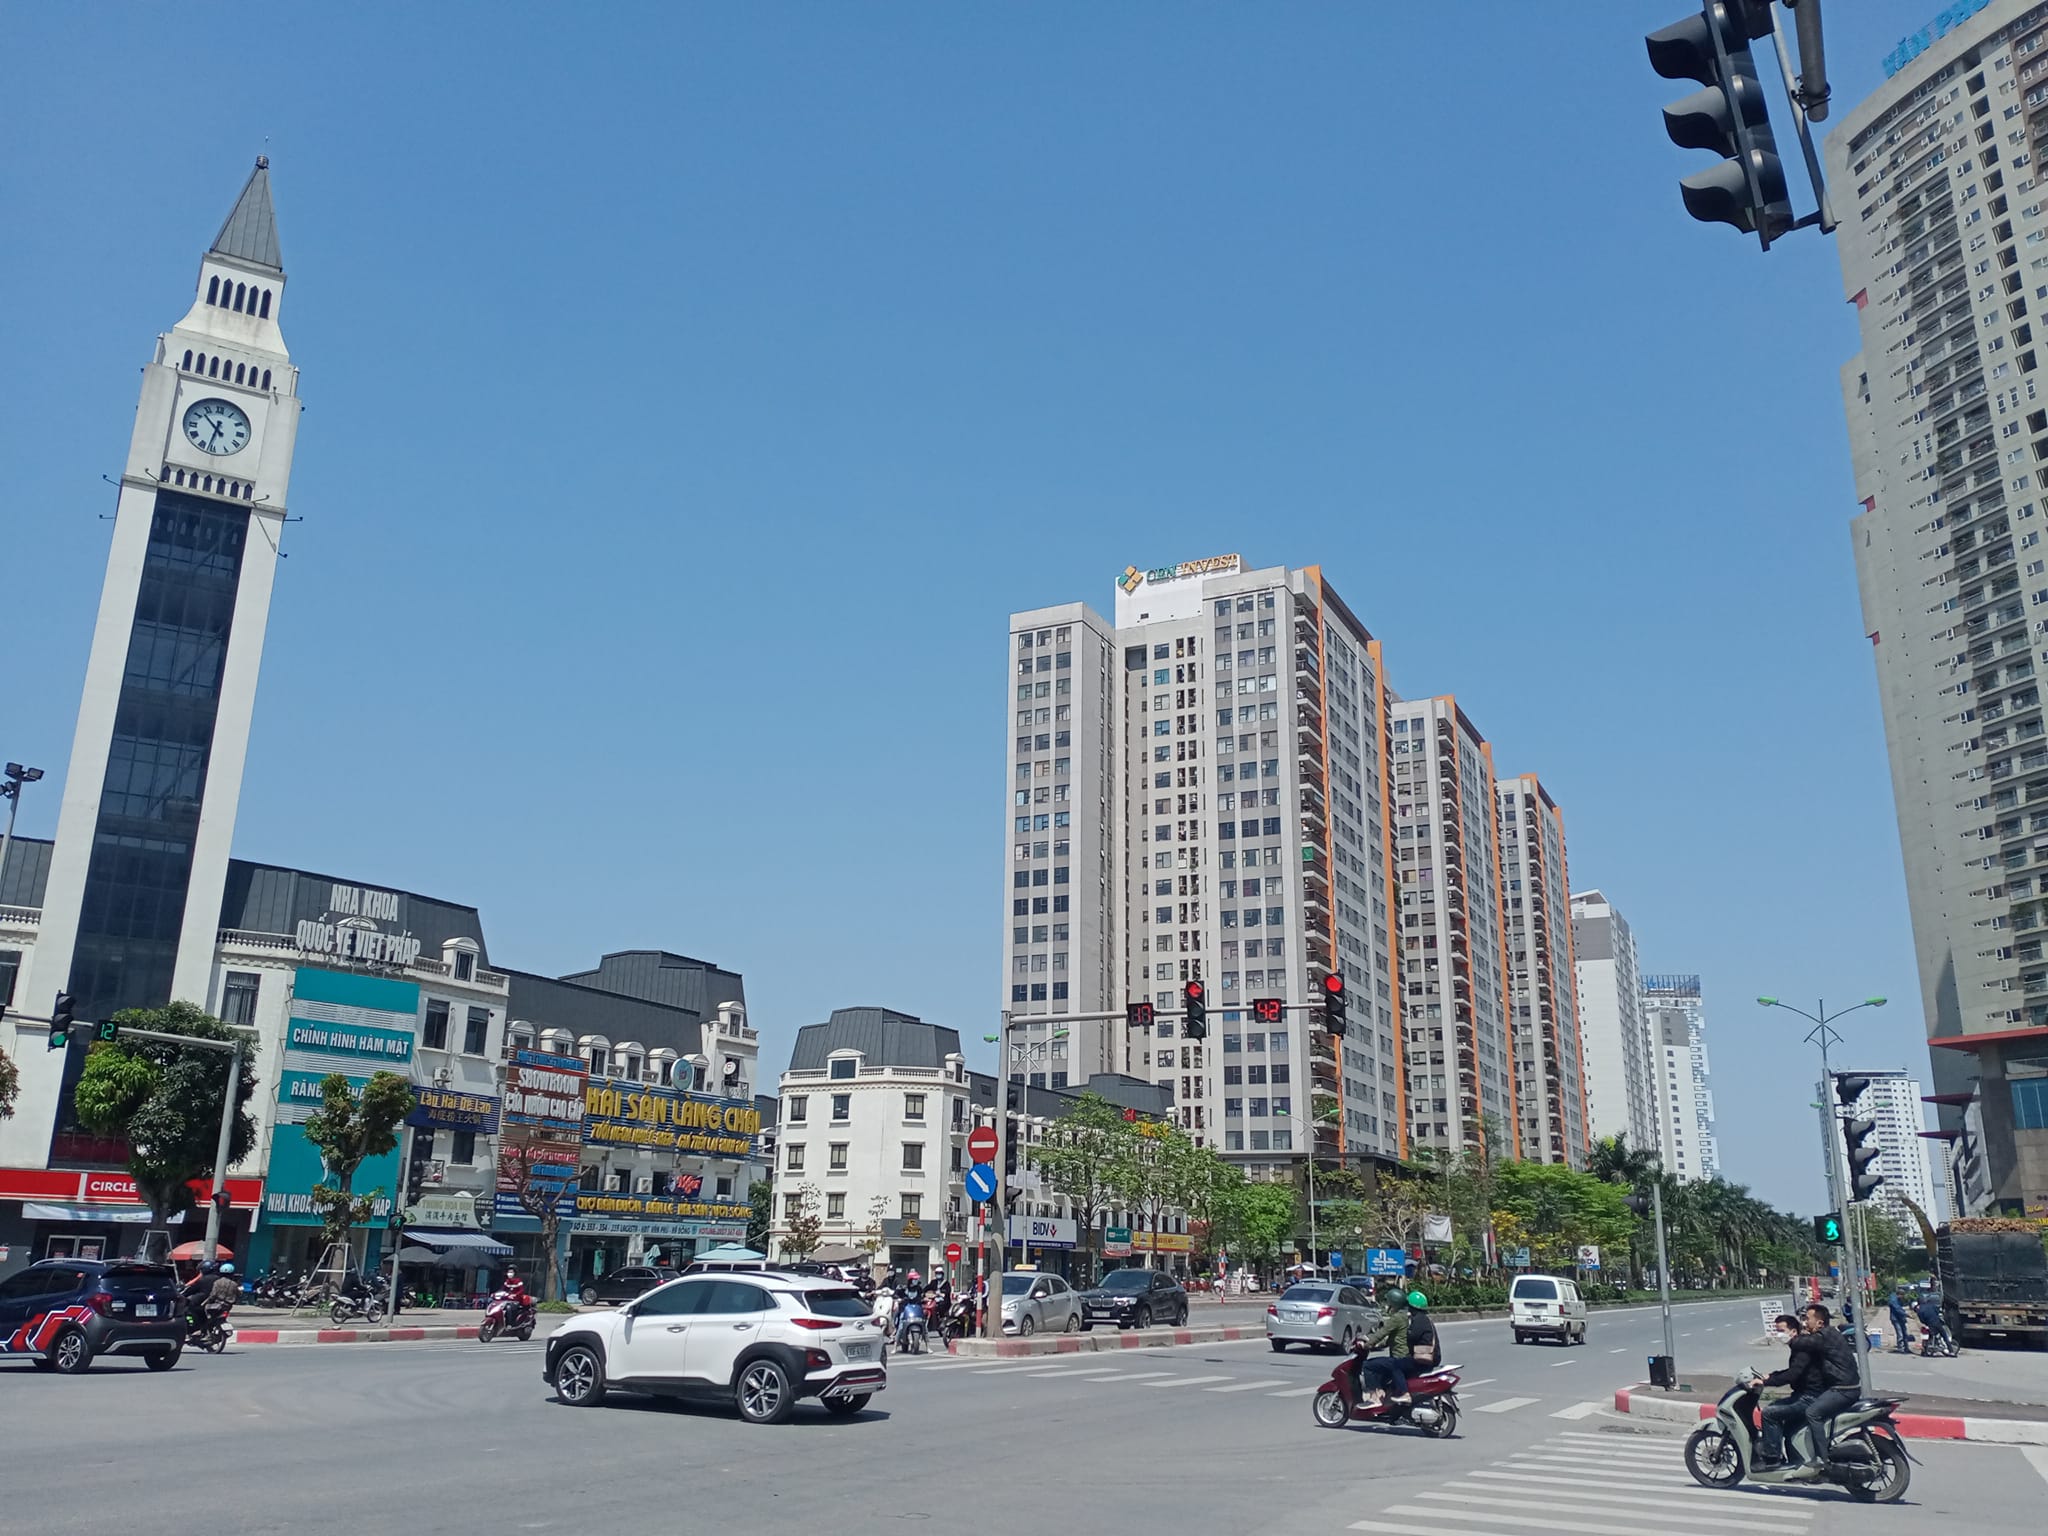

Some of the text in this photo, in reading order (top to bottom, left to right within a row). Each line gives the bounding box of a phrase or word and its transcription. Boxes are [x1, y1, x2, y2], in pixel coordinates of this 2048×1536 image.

[1146, 553, 1238, 583] CEN INVEST
[329, 883, 399, 922] NHA KHOA
[295, 911, 336, 958] QUỐC
[1257, 1001, 1280, 1020] 42
[100, 1022, 115, 1041] 12
[293, 1023, 328, 1046] CHỈNH
[329, 1030, 357, 1049] HÌNH
[518, 1067, 580, 1095] SHOWROOM
[549, 1099, 568, 1118] CAO
[586, 1077, 623, 1118] HẢI
[626, 1084, 667, 1124] SẢN
[671, 1092, 723, 1130] LÀNG
[90, 1181, 137, 1193] CIRCLE
[267, 1193, 287, 1212] NHA
[287, 1194, 312, 1214] KHOA
[1032, 1221, 1050, 1237] BIDV
